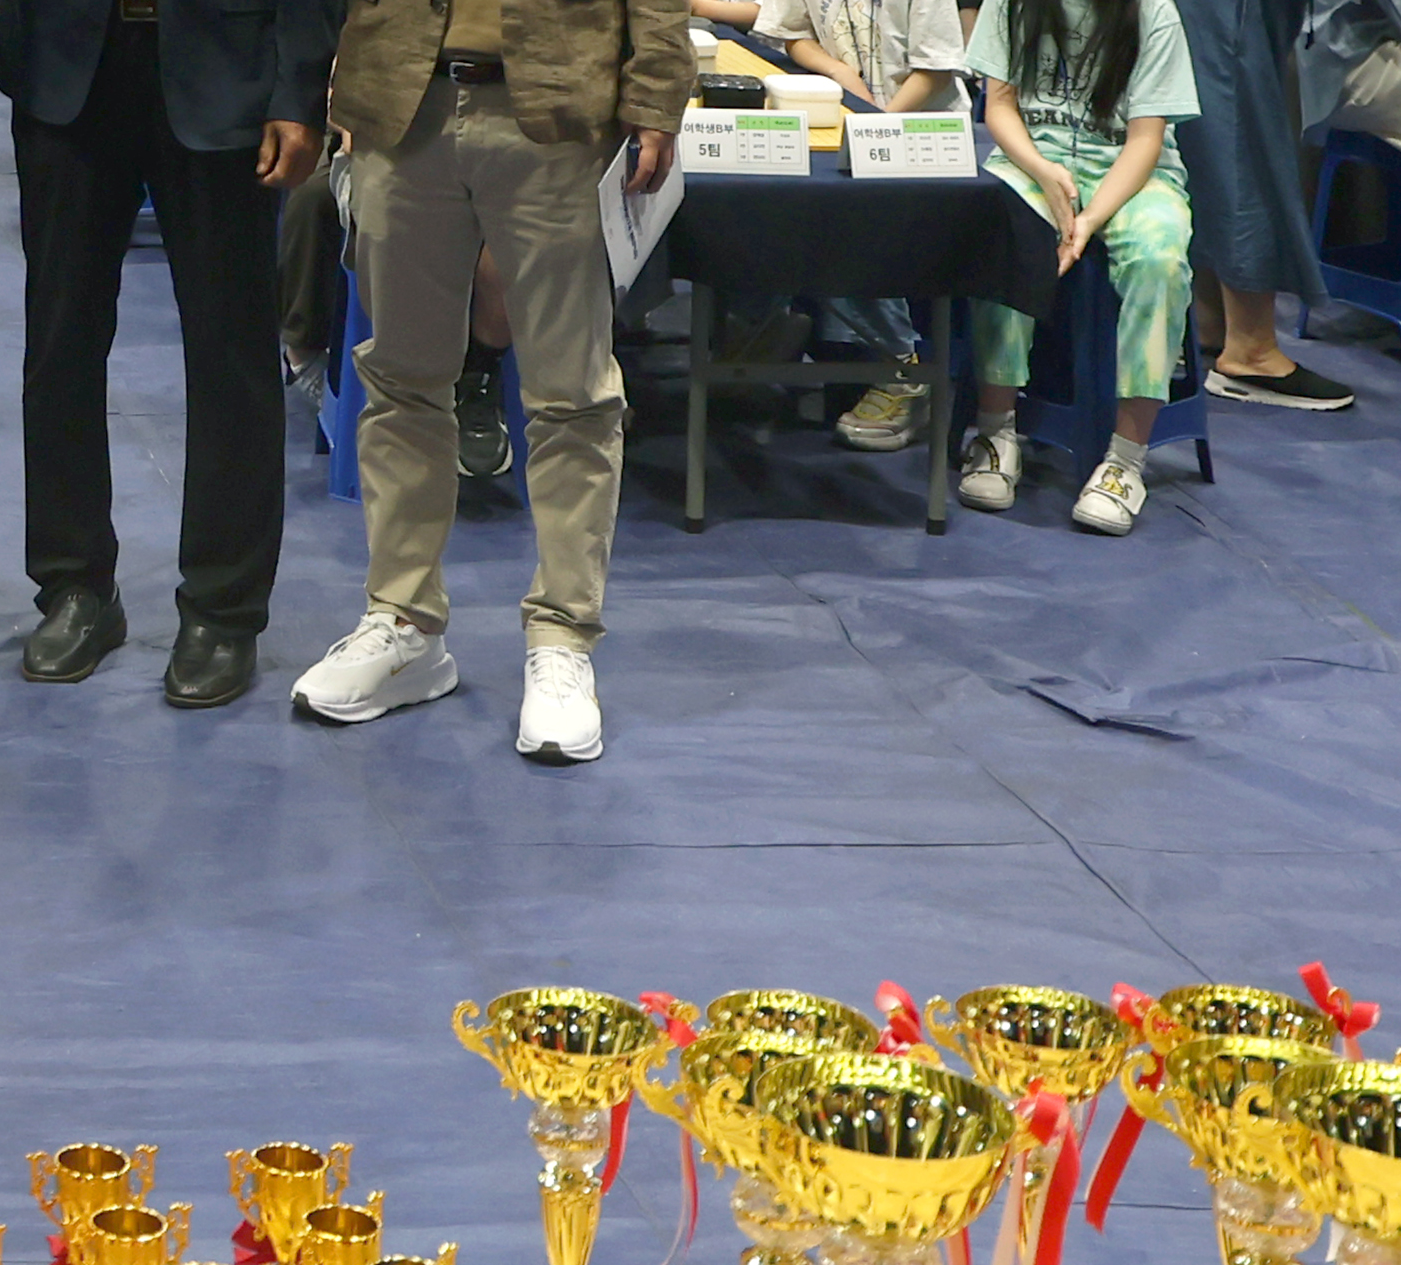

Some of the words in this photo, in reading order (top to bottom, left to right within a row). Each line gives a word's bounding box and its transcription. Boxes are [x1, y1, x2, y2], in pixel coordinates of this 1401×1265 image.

[684, 122, 735, 136] 여학생B부
[854, 126, 902, 140] 여학생B부
[699, 143, 721, 158] 5팀
[869, 148, 891, 163] 6팀
